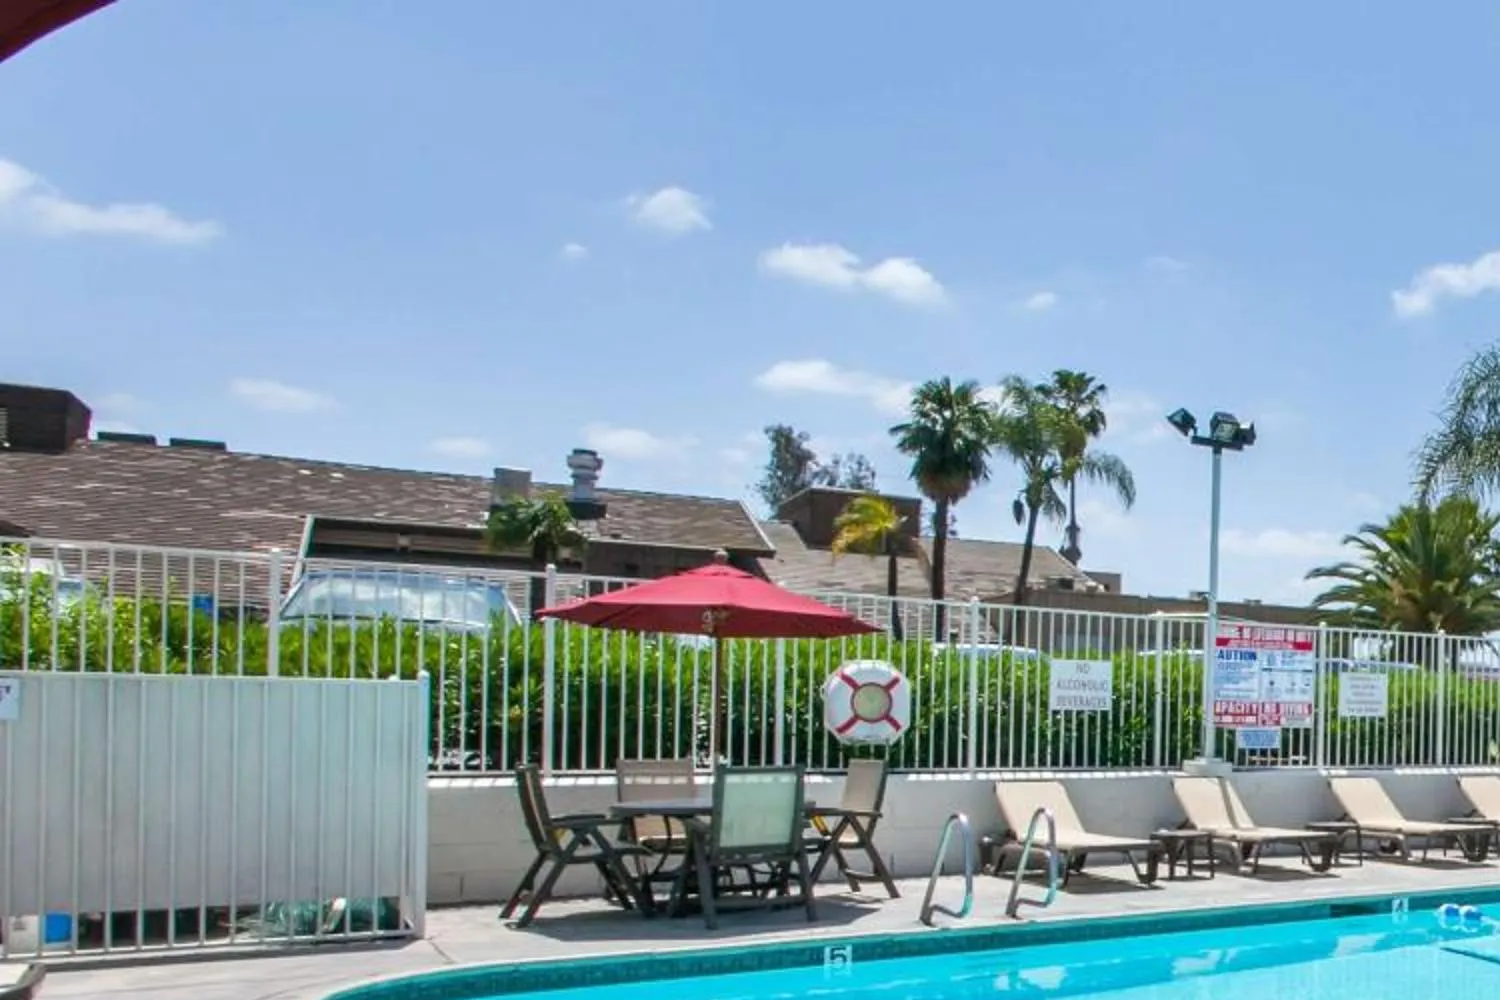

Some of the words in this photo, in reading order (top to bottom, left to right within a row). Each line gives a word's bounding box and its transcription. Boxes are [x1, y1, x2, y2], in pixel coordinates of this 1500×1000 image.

[1216, 649, 1257, 661] AUTION
[1075, 662, 1091, 674] NO
[1215, 701, 1258, 715] APACITY
[830, 947, 848, 968] 5
